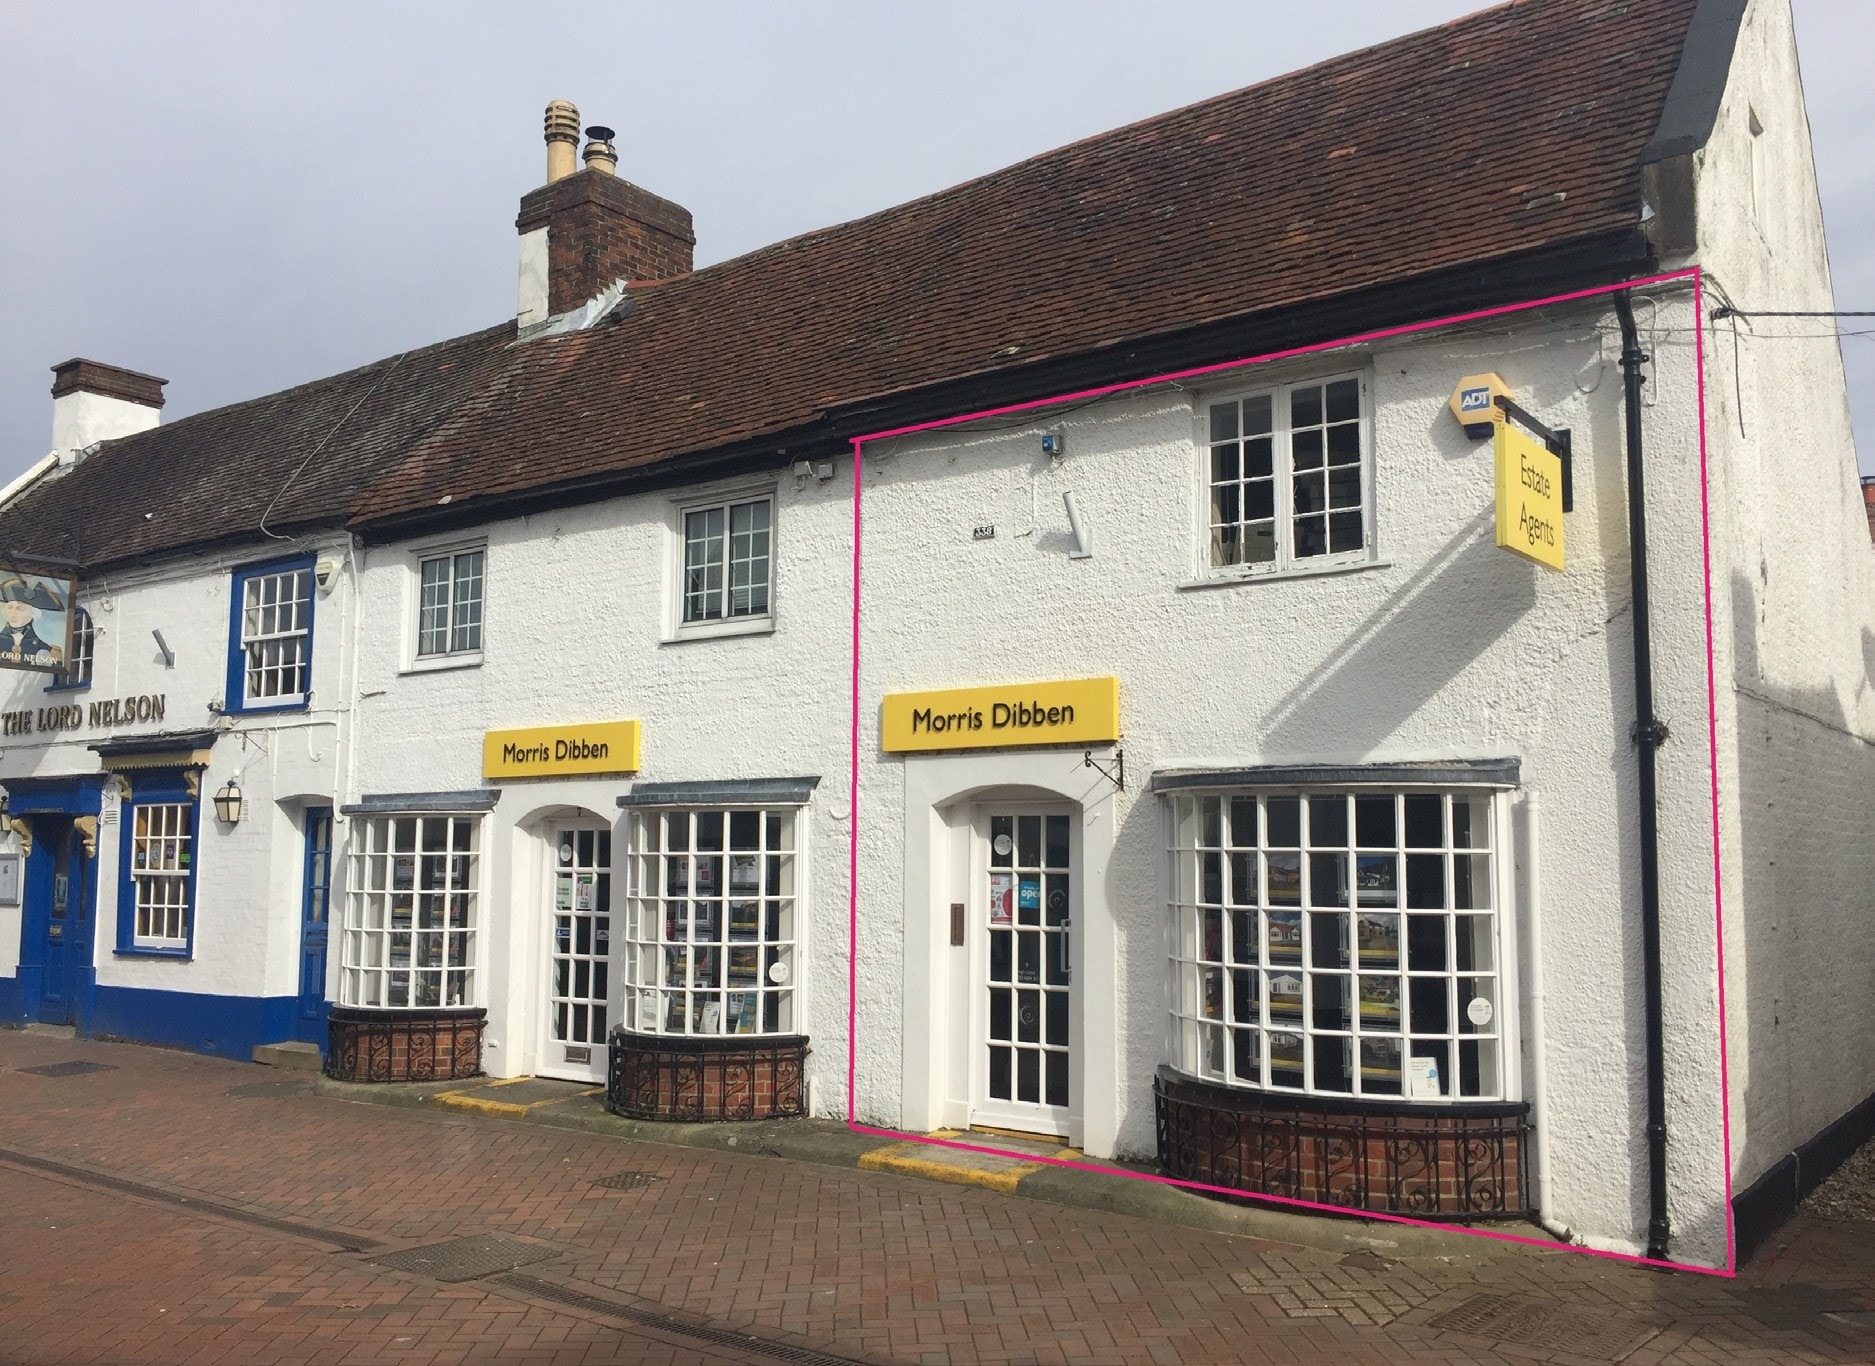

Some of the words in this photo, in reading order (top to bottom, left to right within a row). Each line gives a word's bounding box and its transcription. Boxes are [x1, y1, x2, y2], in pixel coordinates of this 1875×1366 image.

[1461, 392, 1488, 408] ADT
[1520, 453, 1551, 499] Estate
[1519, 500, 1554, 546] Agents
[0, 651, 21, 661] ORD
[23, 653, 58, 665] NELSON
[1, 709, 33, 736] THE
[36, 704, 82, 732] LORD
[88, 694, 165, 728] NELSON
[912, 706, 983, 734] Morris
[991, 700, 1074, 730] Dibben
[503, 742, 549, 764] Morris
[555, 738, 608, 761] Dibben
